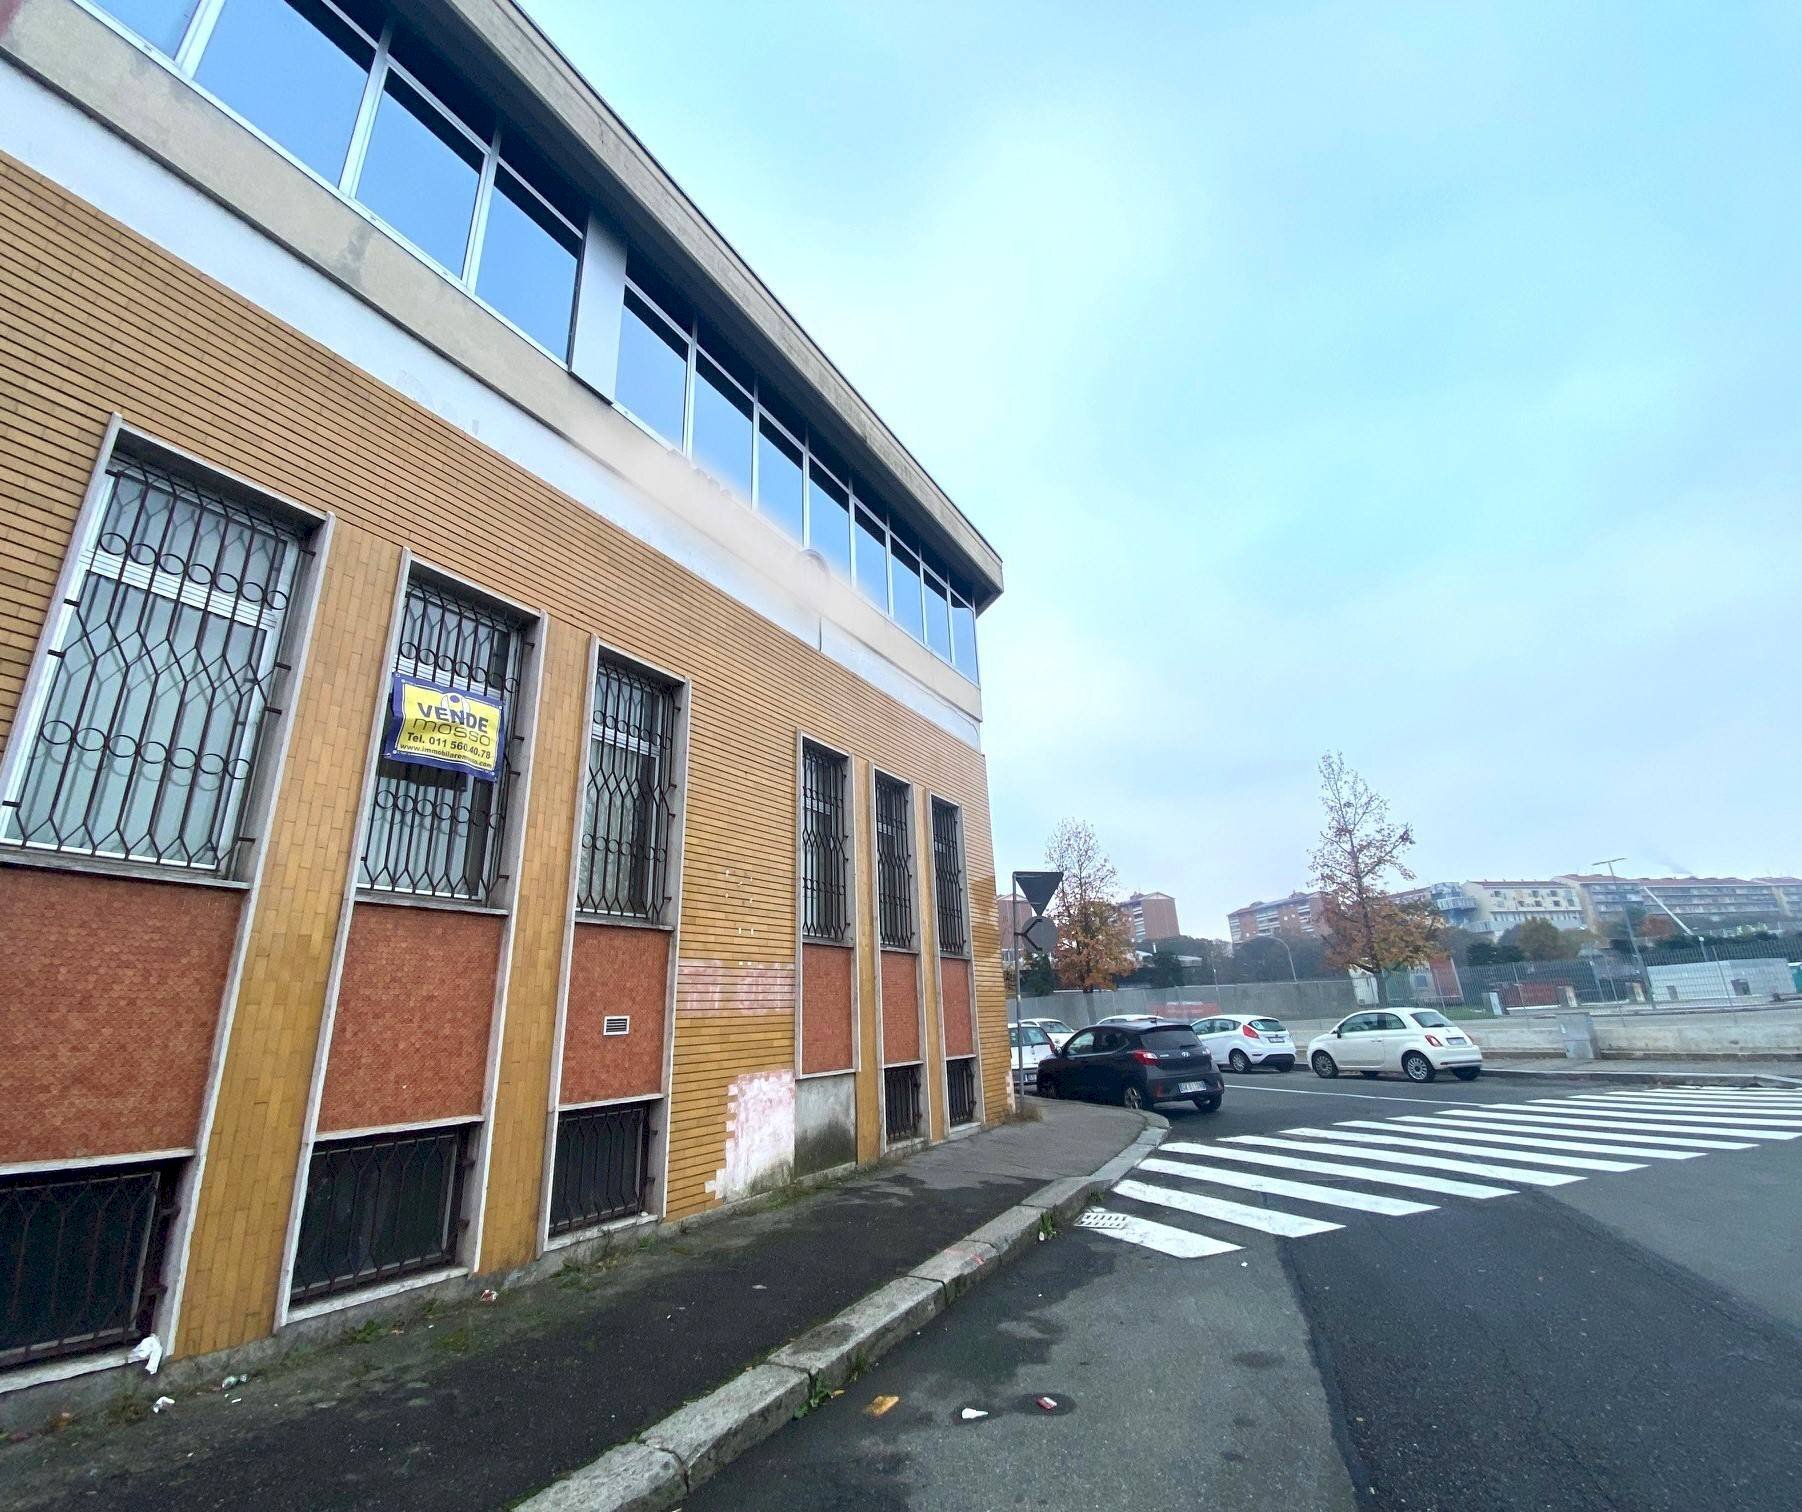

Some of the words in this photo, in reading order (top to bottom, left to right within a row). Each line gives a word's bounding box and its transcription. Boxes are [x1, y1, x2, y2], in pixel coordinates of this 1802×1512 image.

[417, 702, 489, 734] VENDE
[407, 732, 425, 744] Tel.
[429, 736, 447, 748] 011
[450, 740, 491, 760] 560.40.78
